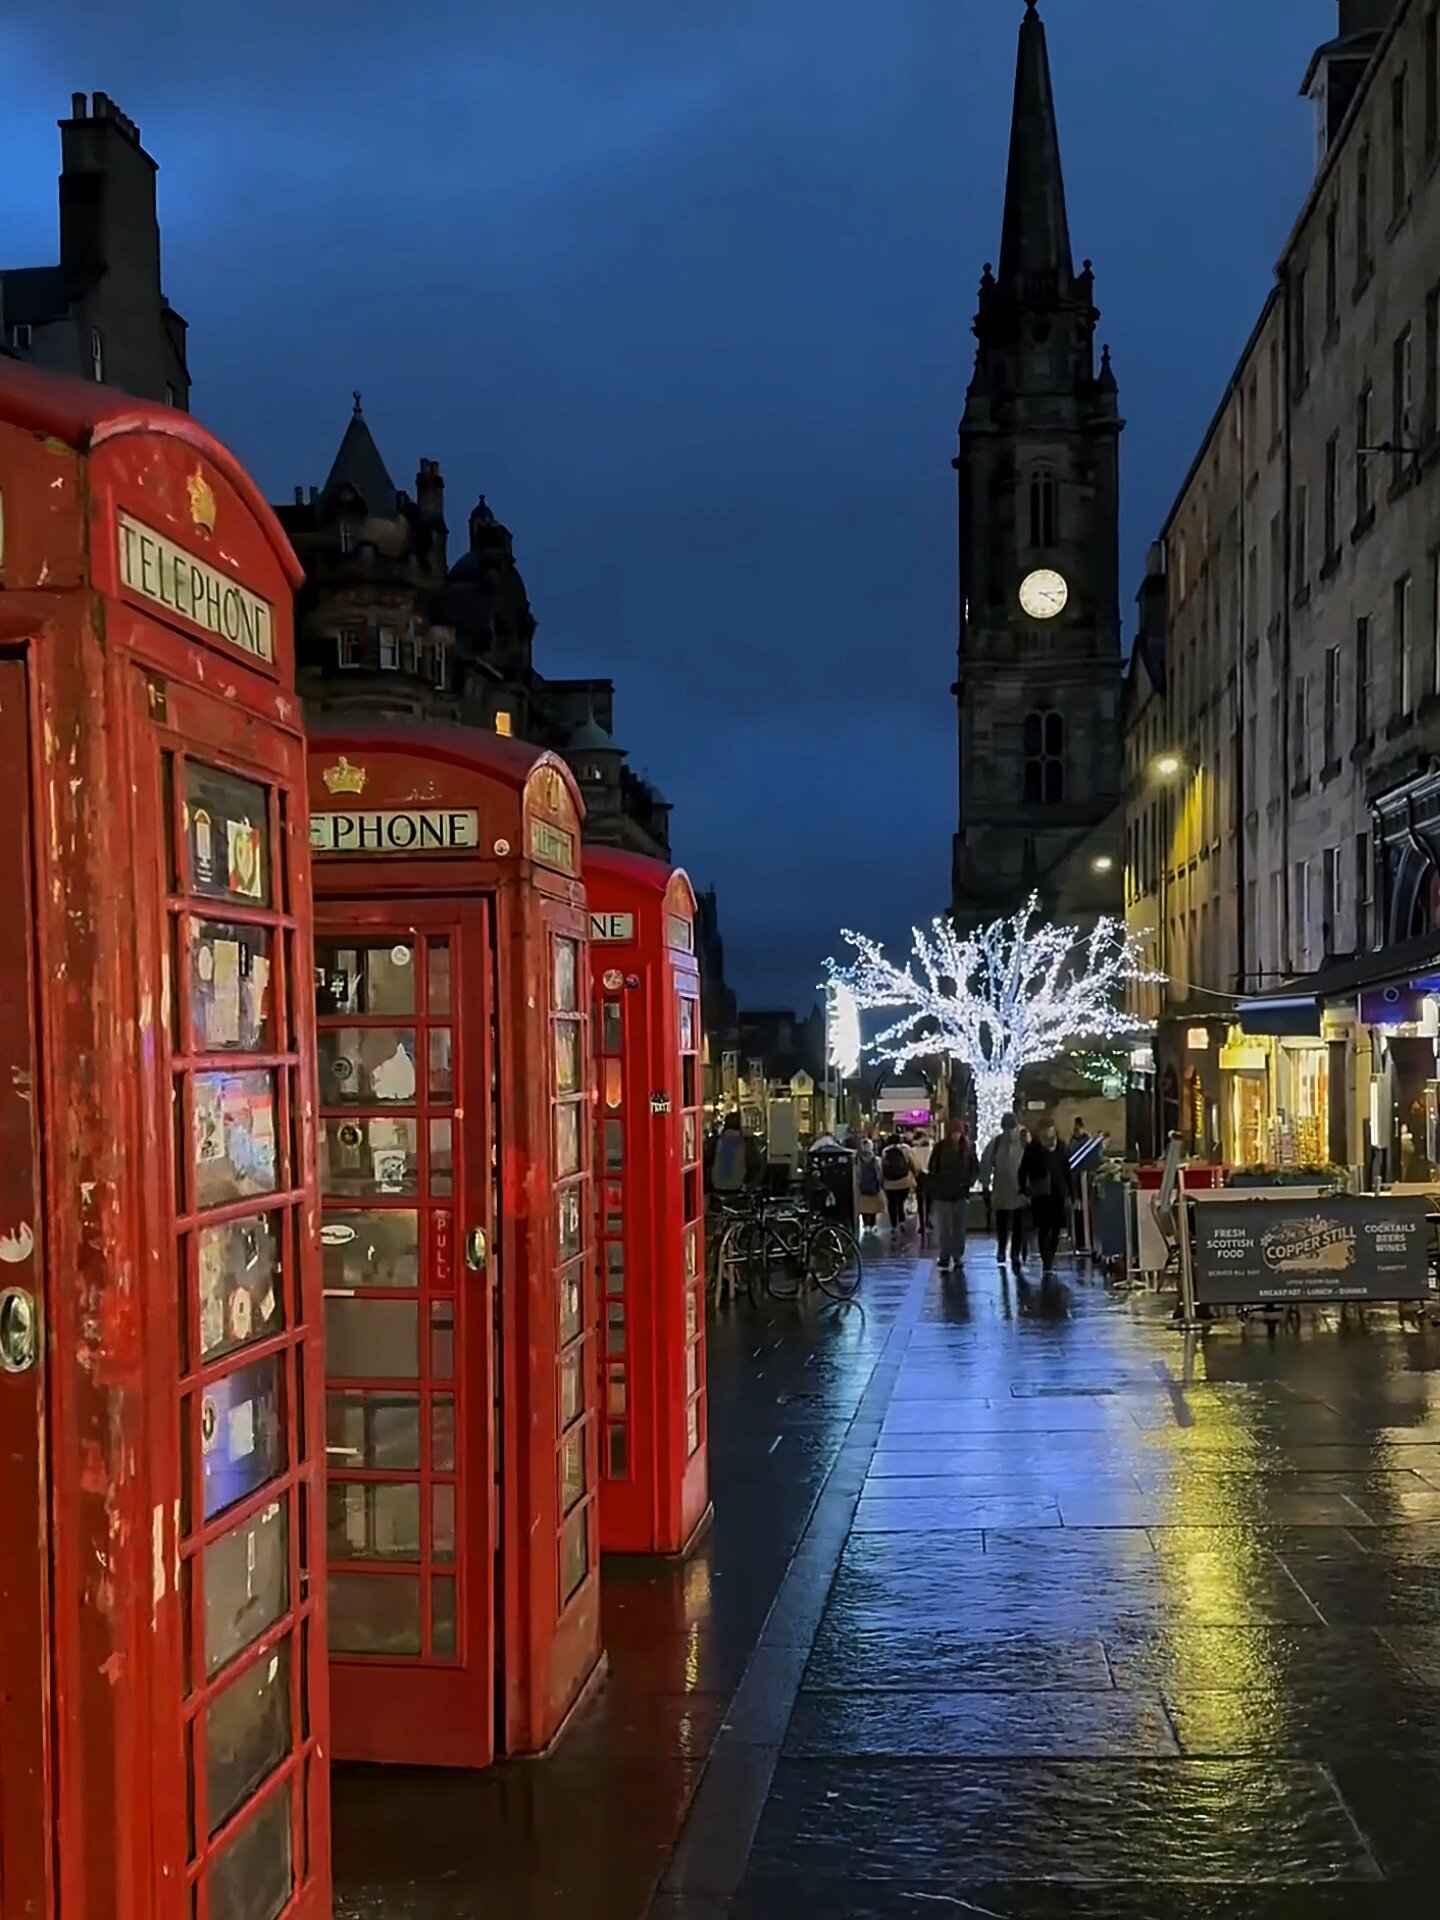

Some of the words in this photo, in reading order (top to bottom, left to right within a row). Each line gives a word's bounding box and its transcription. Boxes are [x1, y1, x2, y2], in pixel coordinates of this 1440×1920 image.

[119, 523, 266, 656] TELEPHONE
[310, 814, 469, 849] EPHONE
[590, 915, 624, 938] NE
[1214, 1228, 1246, 1238] FRESH
[1364, 1223, 1416, 1233] COCKTAILS
[1266, 1236, 1320, 1259] COPPER
[1322, 1226, 1357, 1245] STILL
[1376, 1233, 1406, 1242] BEERS
[437, 1219, 447, 1278] PULL
[1206, 1239, 1254, 1248] SCOTTISH
[1375, 1243, 1407, 1252] WINES
[1217, 1249, 1244, 1258] FOOD
